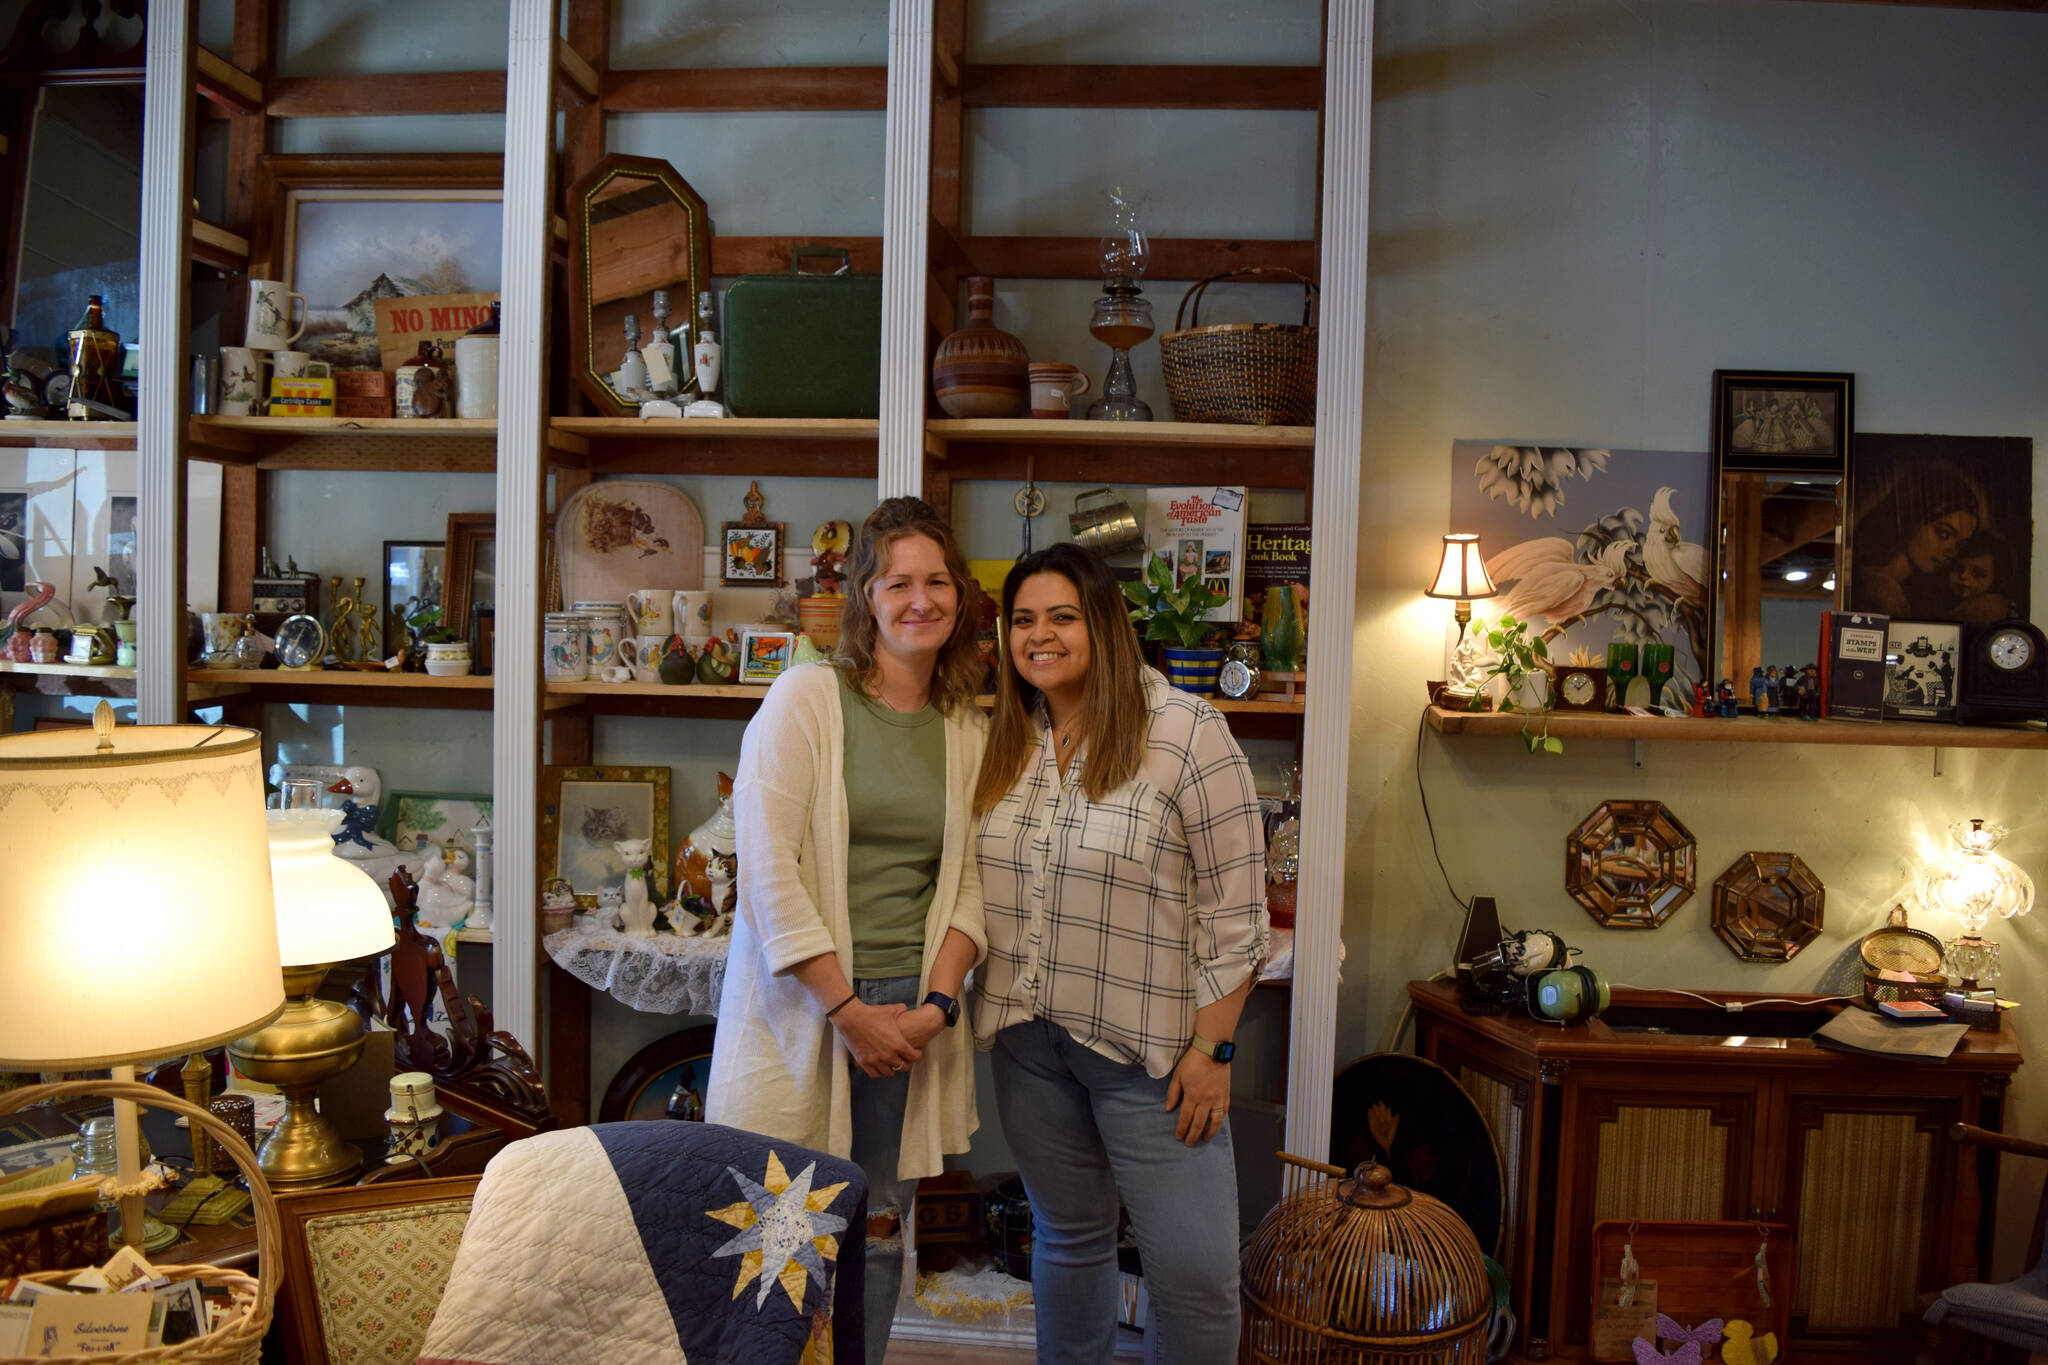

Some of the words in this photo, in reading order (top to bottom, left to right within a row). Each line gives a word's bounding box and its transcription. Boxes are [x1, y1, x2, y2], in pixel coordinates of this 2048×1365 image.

[389, 308, 424, 334] NO
[428, 304, 491, 331] MINO
[1191, 495, 1203, 504] The
[1170, 500, 1214, 510] Evolution
[1175, 509, 1221, 519] American
[1181, 515, 1208, 526] Taste
[1272, 551, 1297, 561] Book
[1846, 639, 1876, 647] STAMPS
[73, 1321, 129, 1334] Silvertone
